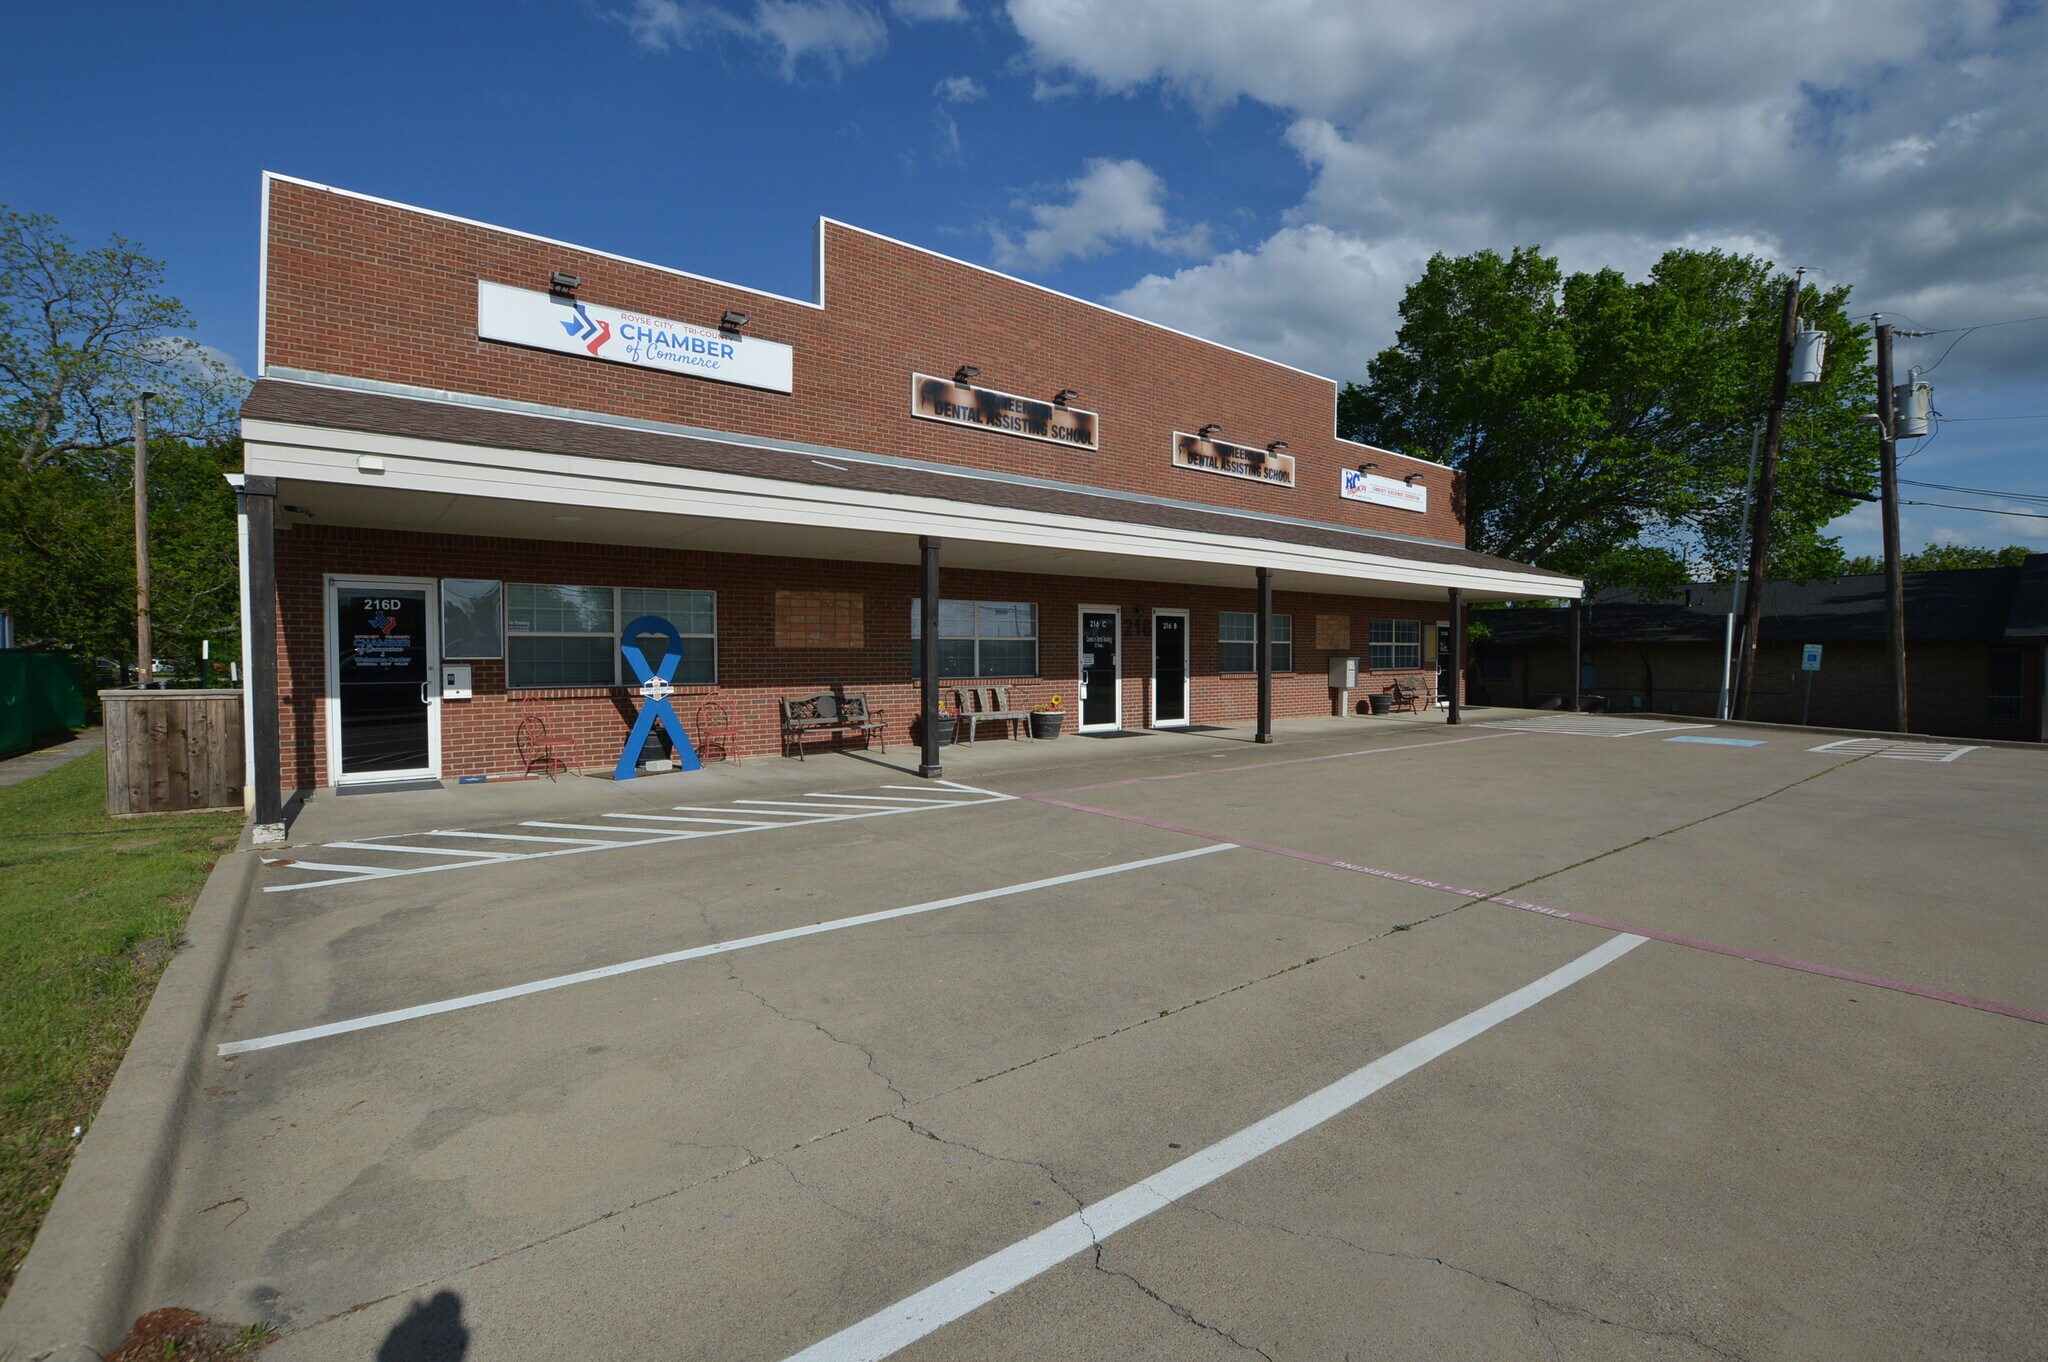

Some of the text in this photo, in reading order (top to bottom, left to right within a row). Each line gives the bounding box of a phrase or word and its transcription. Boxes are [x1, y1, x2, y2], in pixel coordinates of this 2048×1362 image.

[619, 323, 735, 360] CHAMBER
[620, 313, 735, 342] ROYSE CITY TRI-COUNTY
[626, 341, 721, 370] of Commerce
[934, 400, 983, 424] DENTAL
[987, 412, 1048, 436] ASSISTING
[1051, 424, 1094, 445] SCHOOL
[1187, 453, 1292, 483] DENTAL ASSISTING SCHOOL
[363, 598, 401, 610] 216D
[1089, 620, 1107, 628] 216 C
[1162, 622, 1178, 630] 216 B
[1329, 860, 1571, 919] FIRE LNE NO PARKING
